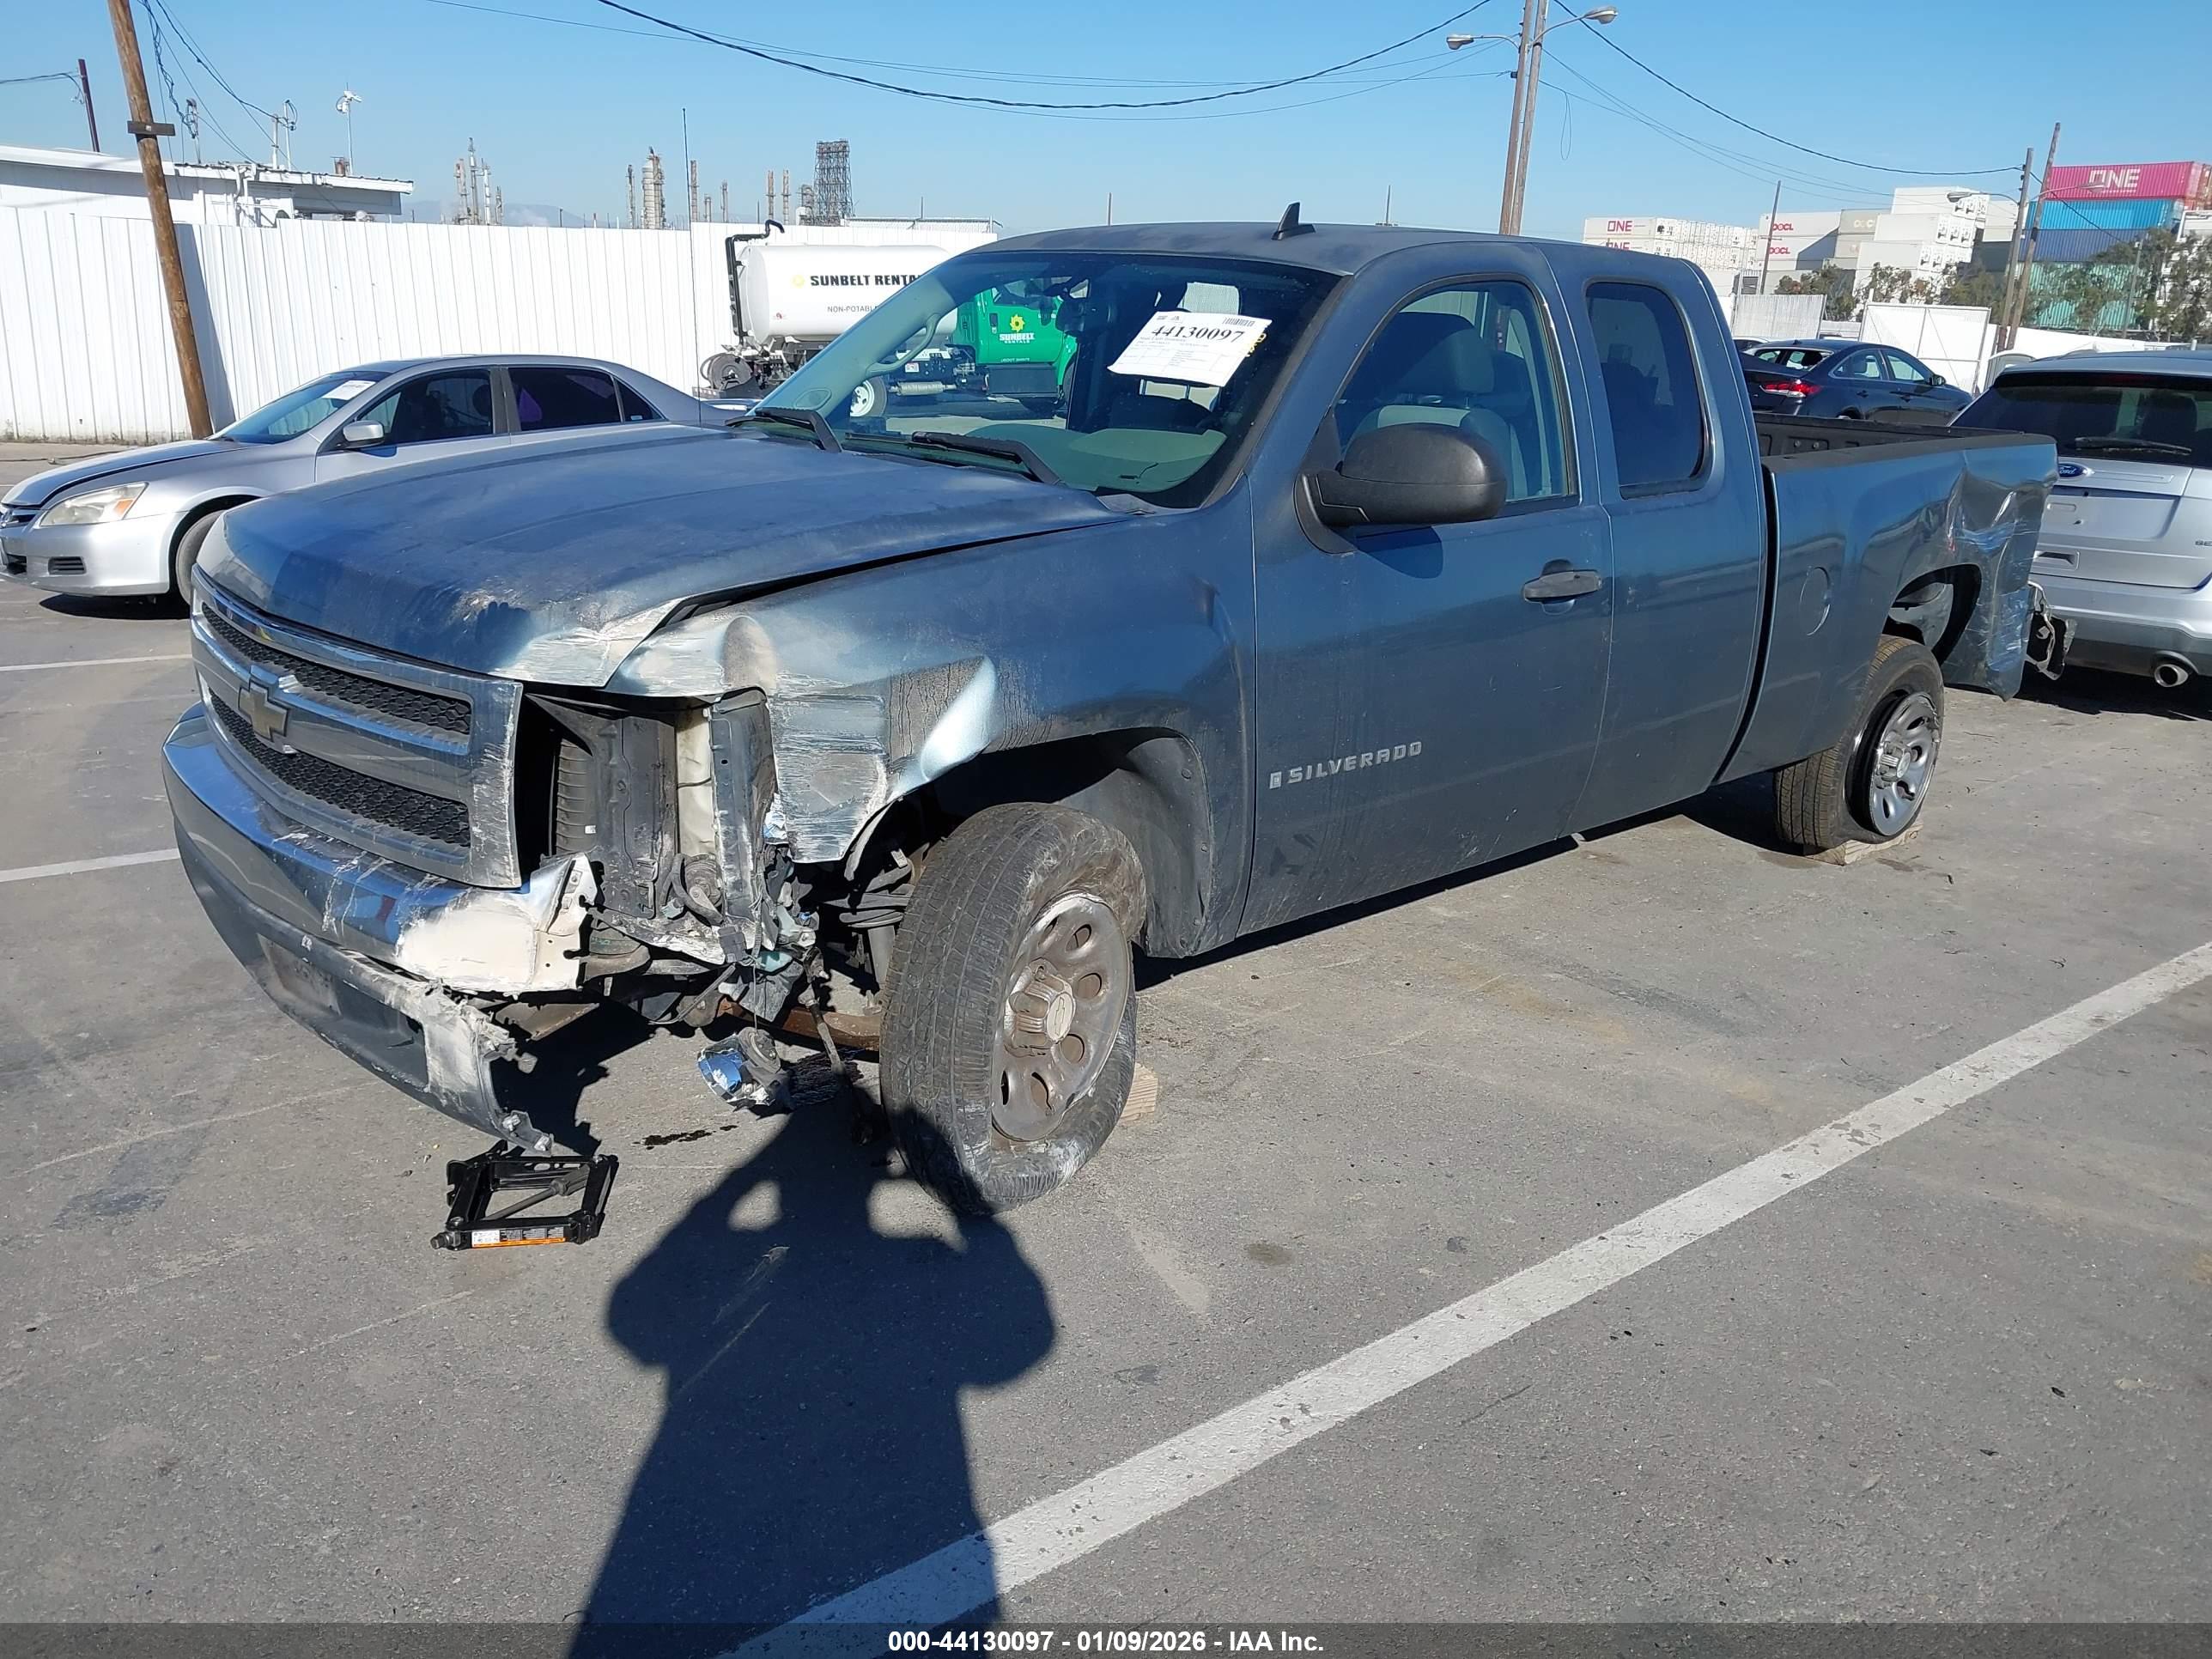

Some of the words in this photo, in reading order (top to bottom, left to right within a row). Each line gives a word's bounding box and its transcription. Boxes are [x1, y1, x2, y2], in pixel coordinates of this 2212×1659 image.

[2088, 168, 2141, 188] ONE
[1607, 220, 1633, 232] ONE
[810, 275, 871, 286] SUNBELT
[874, 274, 921, 287] RENTA
[999, 332, 1035, 341] SUNBELT
[1152, 325, 1246, 343] 44130097
[1287, 741, 1423, 784] SILVERADO
